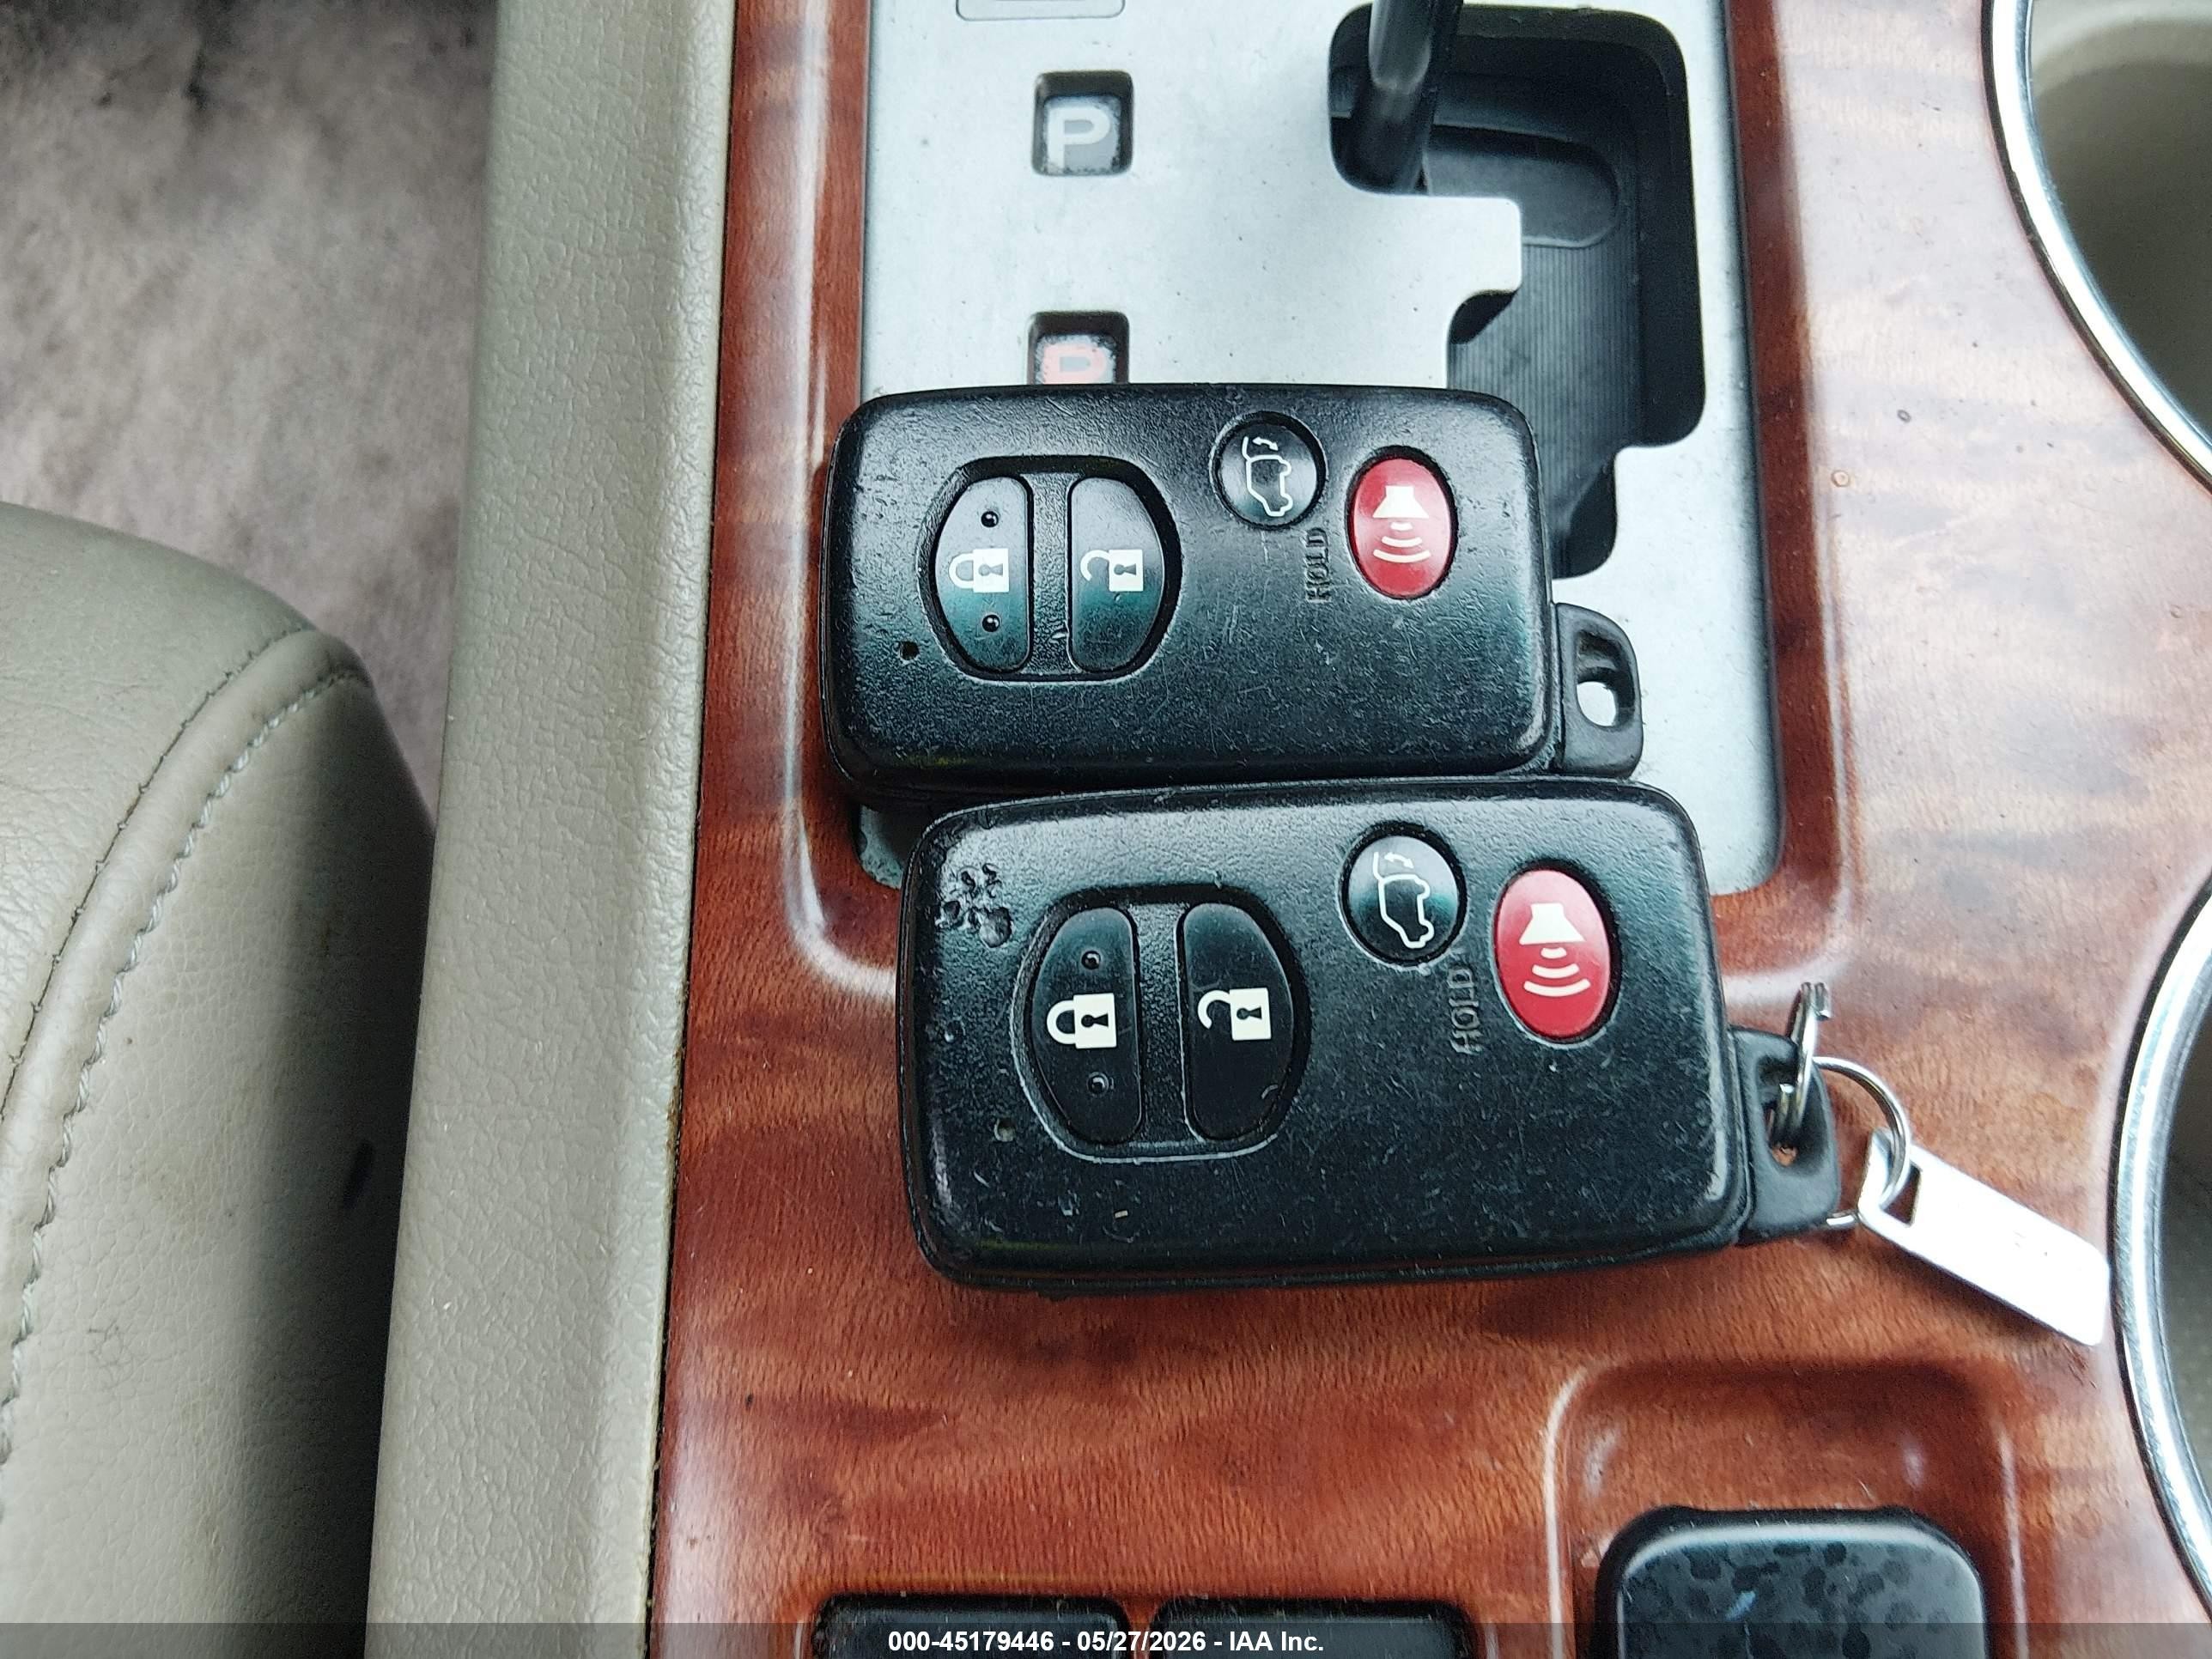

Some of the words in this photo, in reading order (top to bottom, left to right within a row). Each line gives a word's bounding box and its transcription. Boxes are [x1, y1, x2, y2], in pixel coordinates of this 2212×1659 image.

[1048, 106, 1111, 173] P
[1304, 526, 1332, 602] HOLD
[1447, 964, 1483, 1054] HOLD
